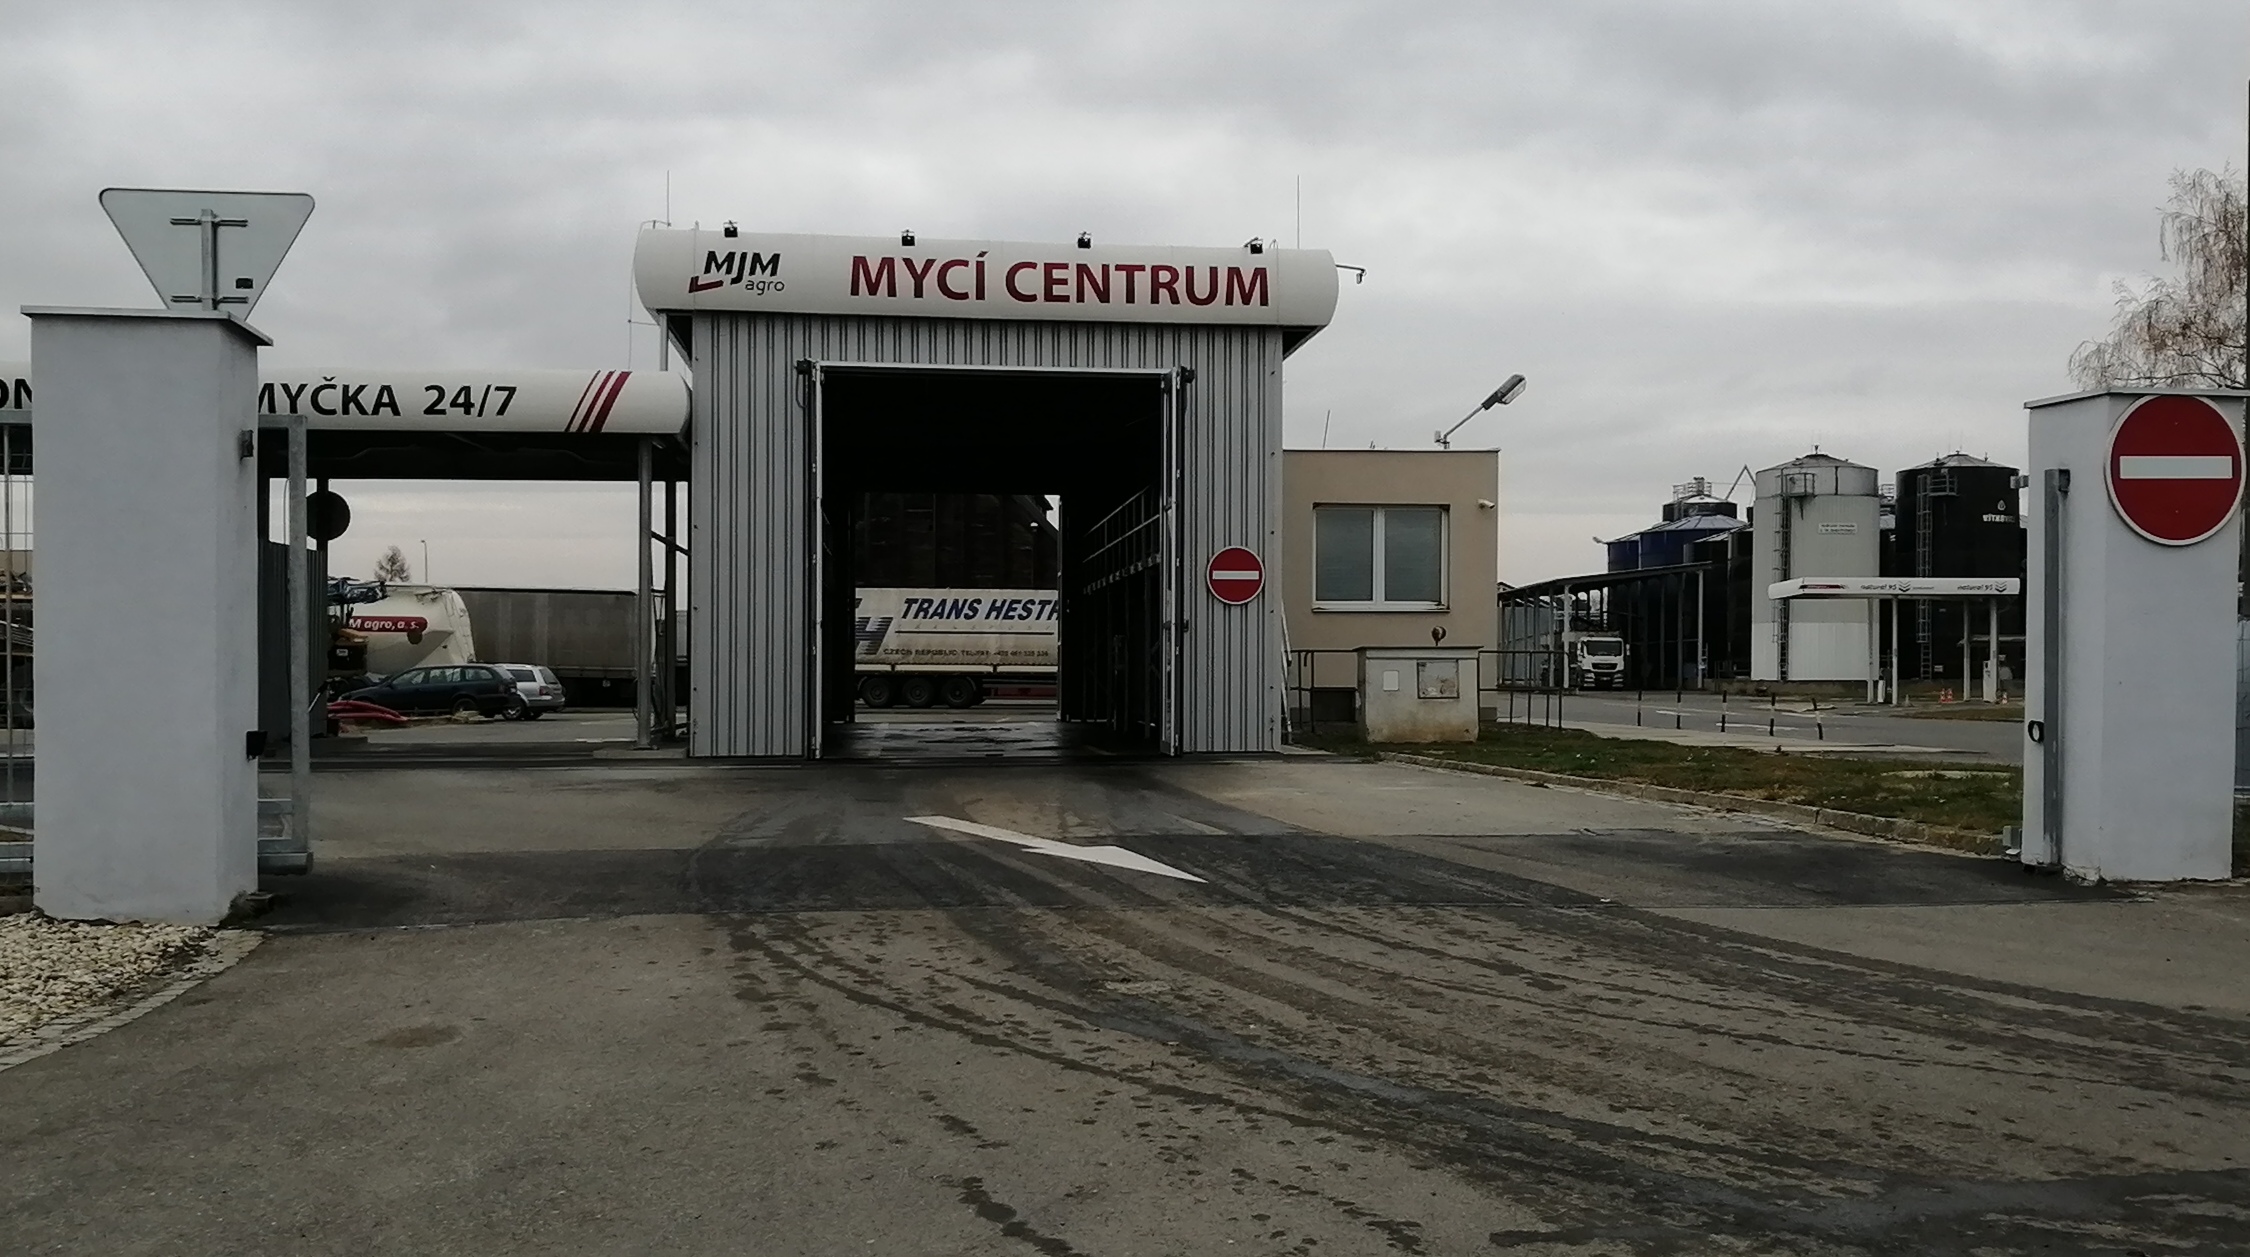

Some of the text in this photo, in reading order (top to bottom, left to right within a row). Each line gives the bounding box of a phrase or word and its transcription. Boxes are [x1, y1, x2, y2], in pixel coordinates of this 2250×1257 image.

[704, 251, 781, 285] MJM
[850, 251, 1269, 307] MYCÍ CENTRUM
[745, 280, 785, 295] agro
[423, 384, 517, 418] 24/7
[901, 598, 982, 620] TRANS
